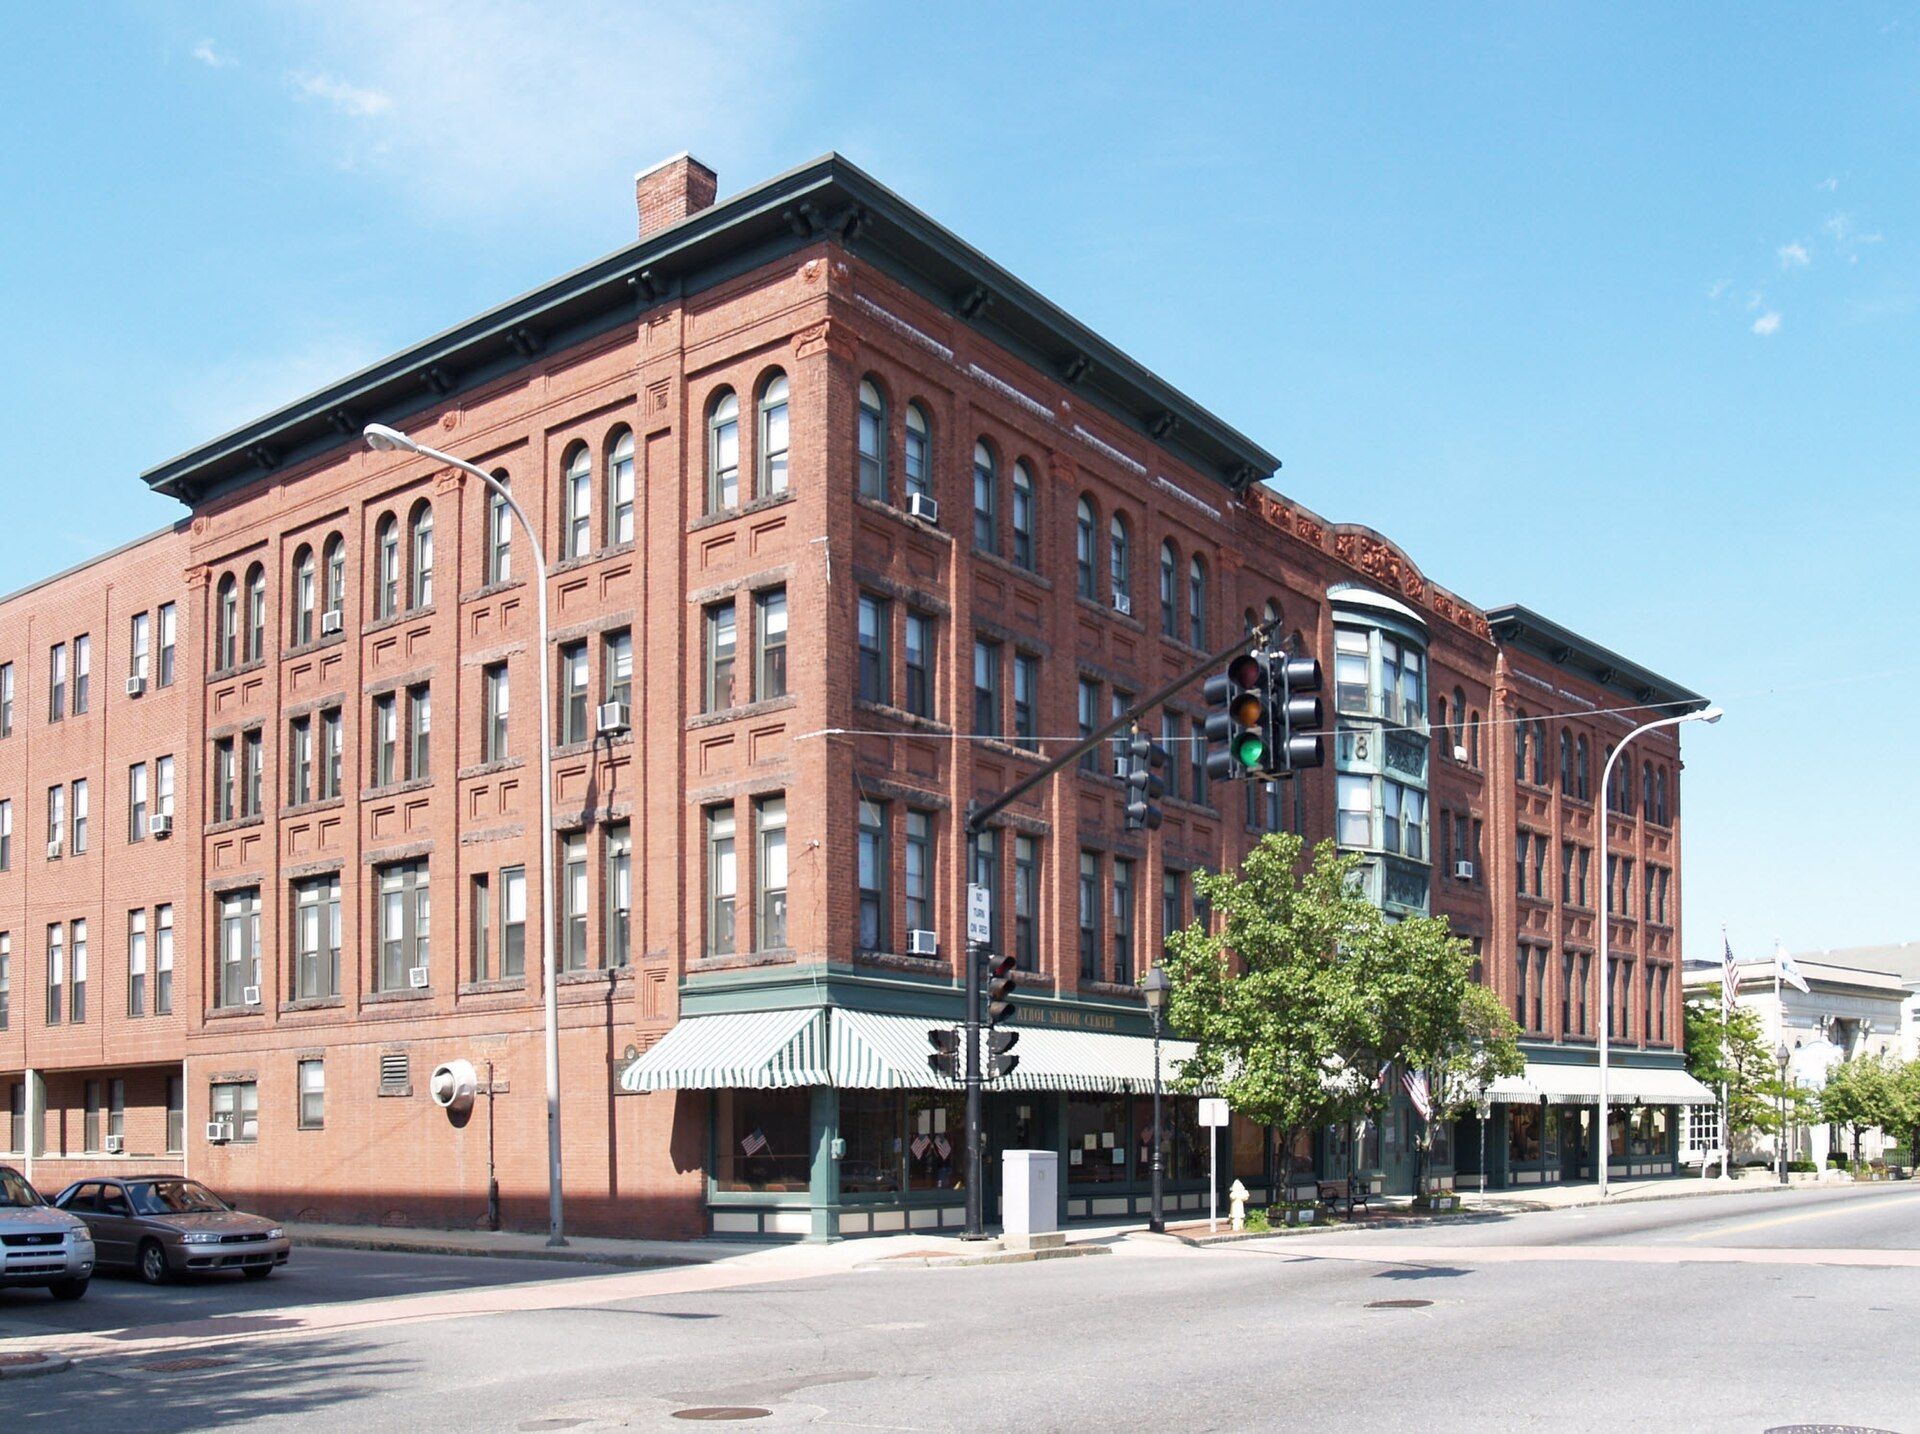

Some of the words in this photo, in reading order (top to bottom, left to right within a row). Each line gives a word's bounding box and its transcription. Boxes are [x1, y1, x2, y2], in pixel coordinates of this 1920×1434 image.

[976, 892, 983, 902] NO
[974, 907, 985, 919] TURN
[970, 922, 977, 933] ON
[979, 924, 988, 935] RED
[1016, 1007, 1045, 1023] ATHOL
[1049, 1010, 1080, 1026] SENIOR
[1084, 1013, 1116, 1029] CENTER
